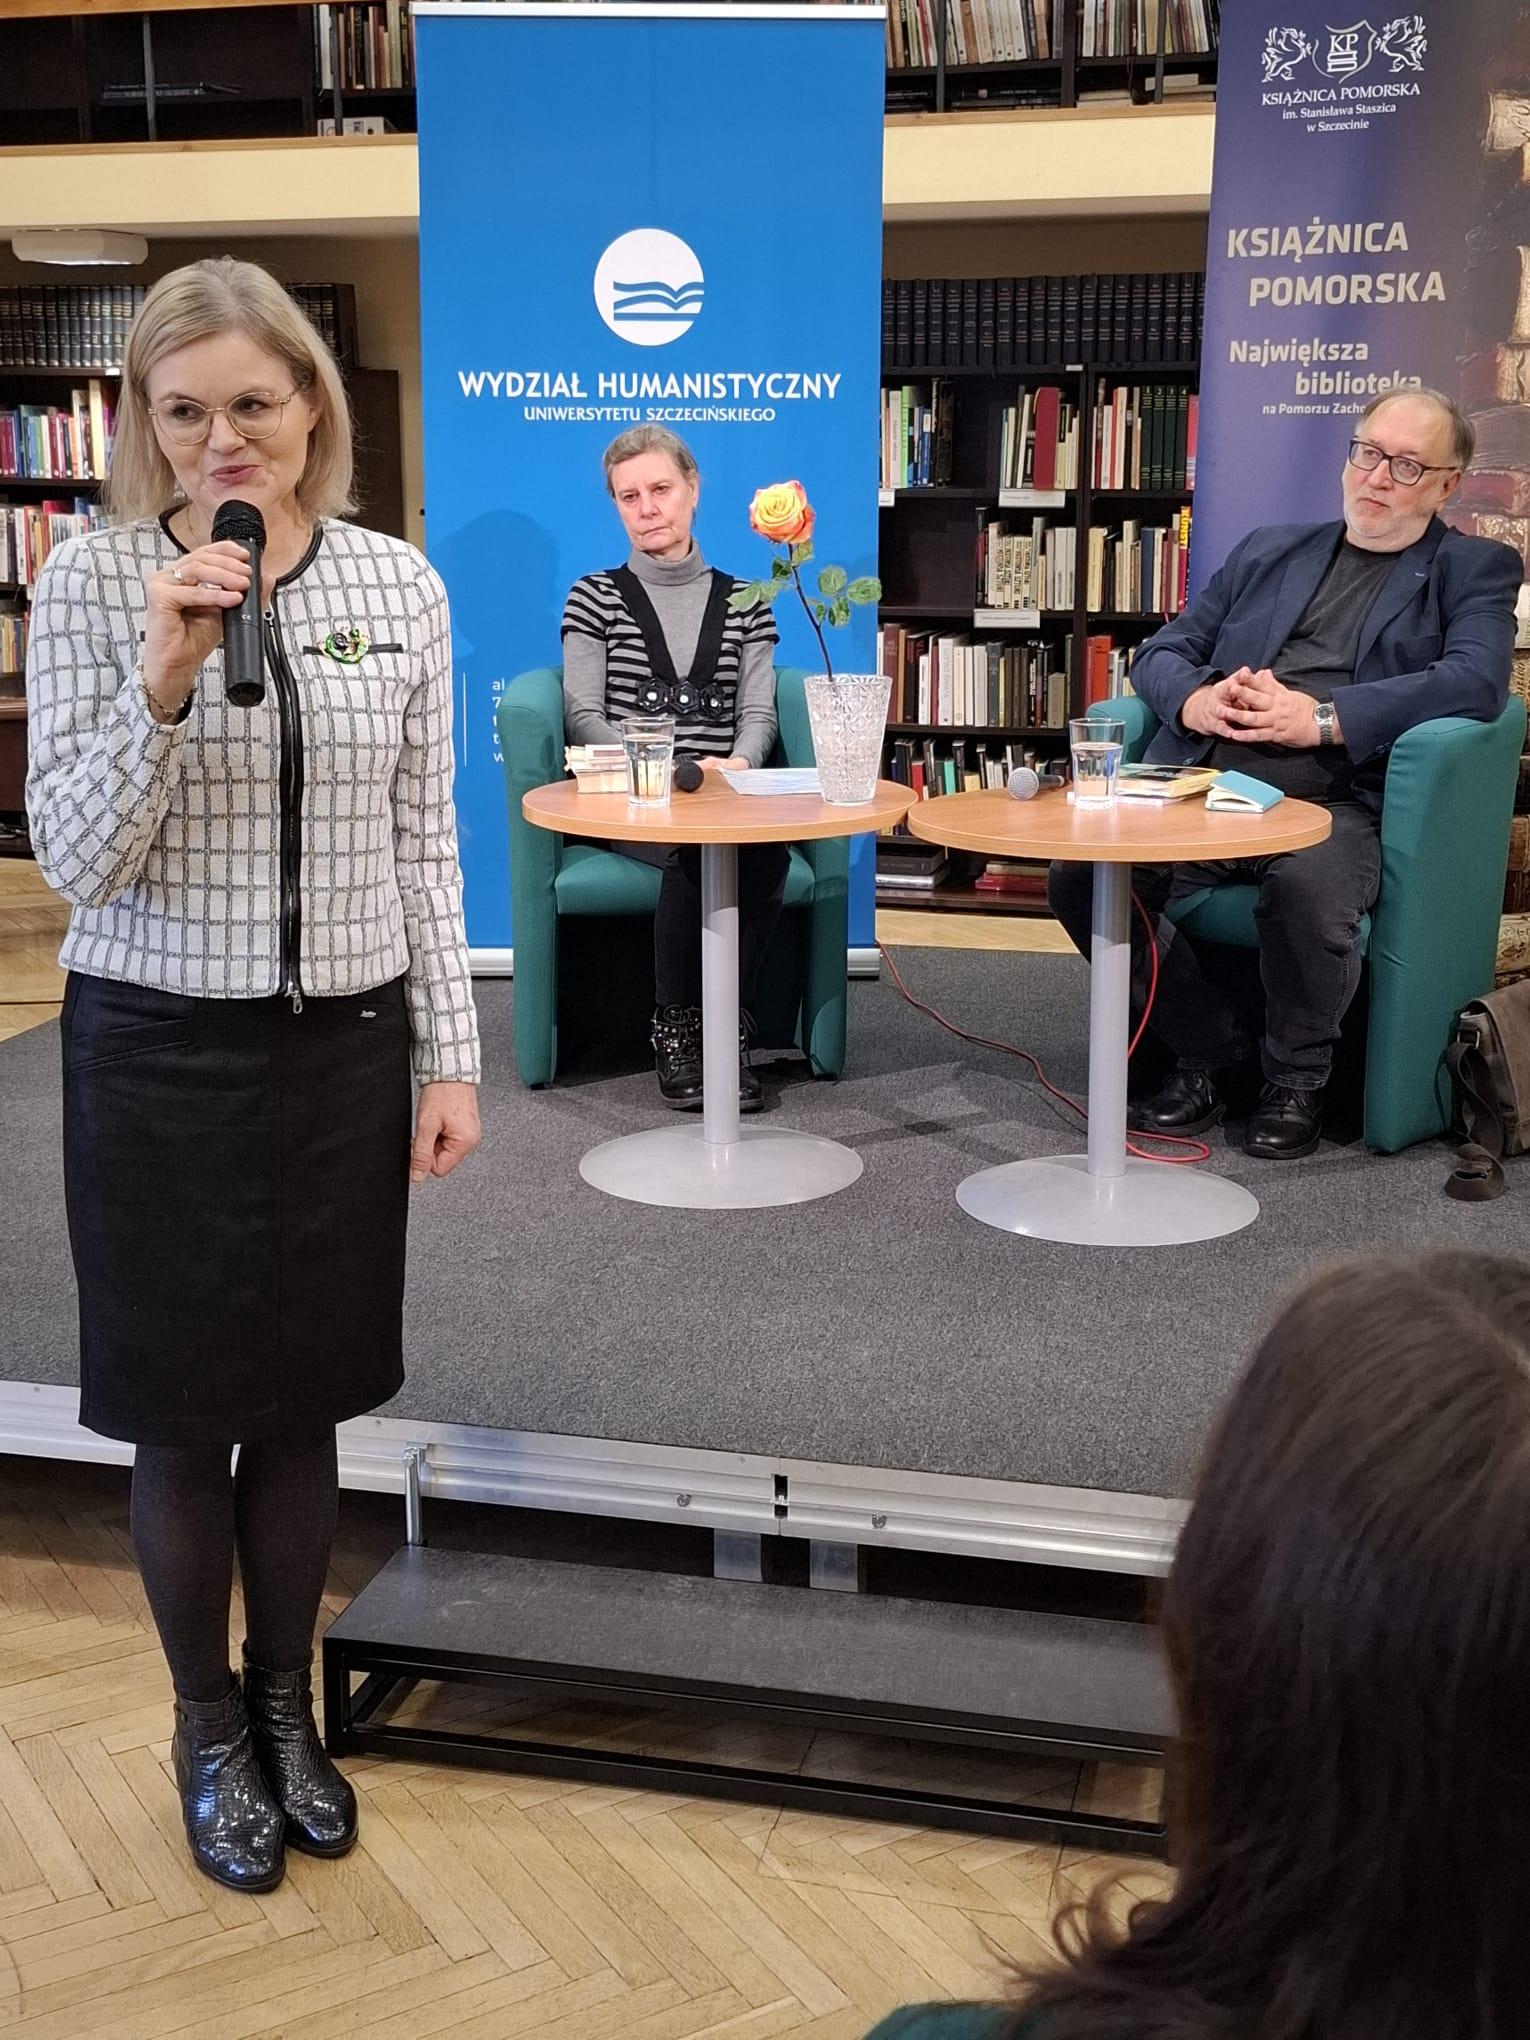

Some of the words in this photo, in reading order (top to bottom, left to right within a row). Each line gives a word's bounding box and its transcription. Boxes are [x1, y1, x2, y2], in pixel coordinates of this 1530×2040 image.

[1329, 33, 1359, 52] KP
[1261, 88, 1337, 107] KSIĄŻNICA
[1340, 82, 1421, 100] POMORSKA
[1282, 108, 1299, 120] im.
[1300, 105, 1354, 119] Stanisława
[1355, 102, 1397, 114] Staszica
[1306, 123, 1317, 132] w
[1317, 119, 1370, 132] Szczecinie
[1226, 216, 1409, 264] KSIĄŻNICA
[1248, 271, 1446, 307] POMORSKA
[1229, 338, 1369, 368] Największa
[458, 371, 588, 399] WYDZIAŁ
[598, 372, 842, 400] HUMANISTYCZNY
[1295, 370, 1422, 396] biblioteka
[523, 407, 641, 421] UNIWERSYTETU
[646, 405, 776, 422] SZCZECIŃSKIEGO
[1262, 405, 1276, 415] na
[1278, 403, 1330, 415] Pomorzu
